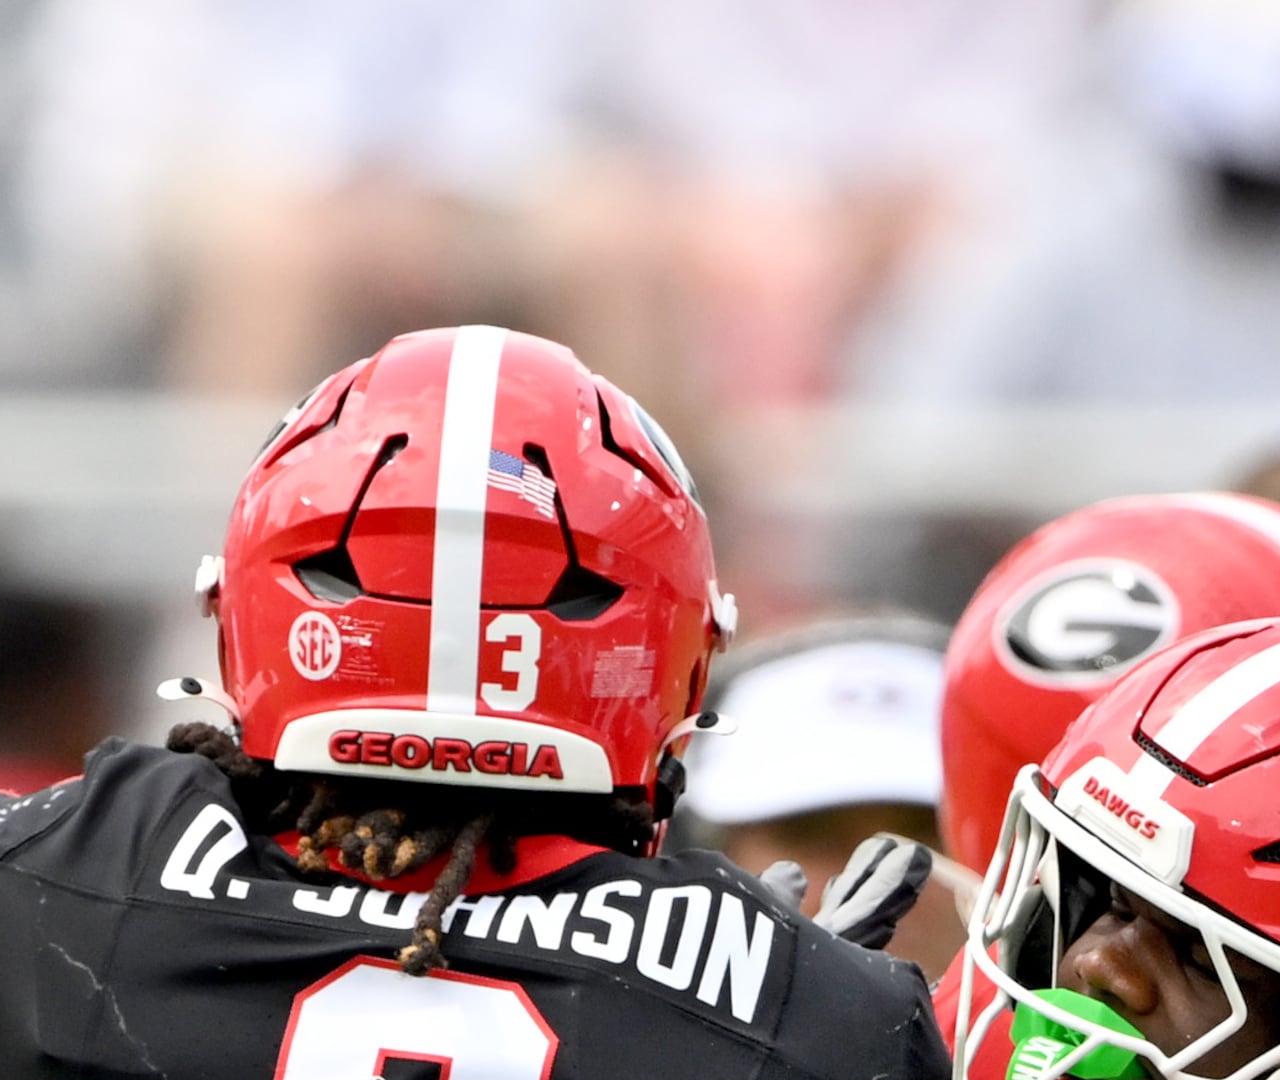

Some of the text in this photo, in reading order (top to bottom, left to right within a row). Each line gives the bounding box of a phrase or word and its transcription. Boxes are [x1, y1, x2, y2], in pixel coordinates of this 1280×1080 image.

[481, 613, 541, 712] 3
[328, 729, 564, 780] GEORGIA
[1082, 775, 1161, 841] DAWGS
[160, 803, 251, 900] Q.
